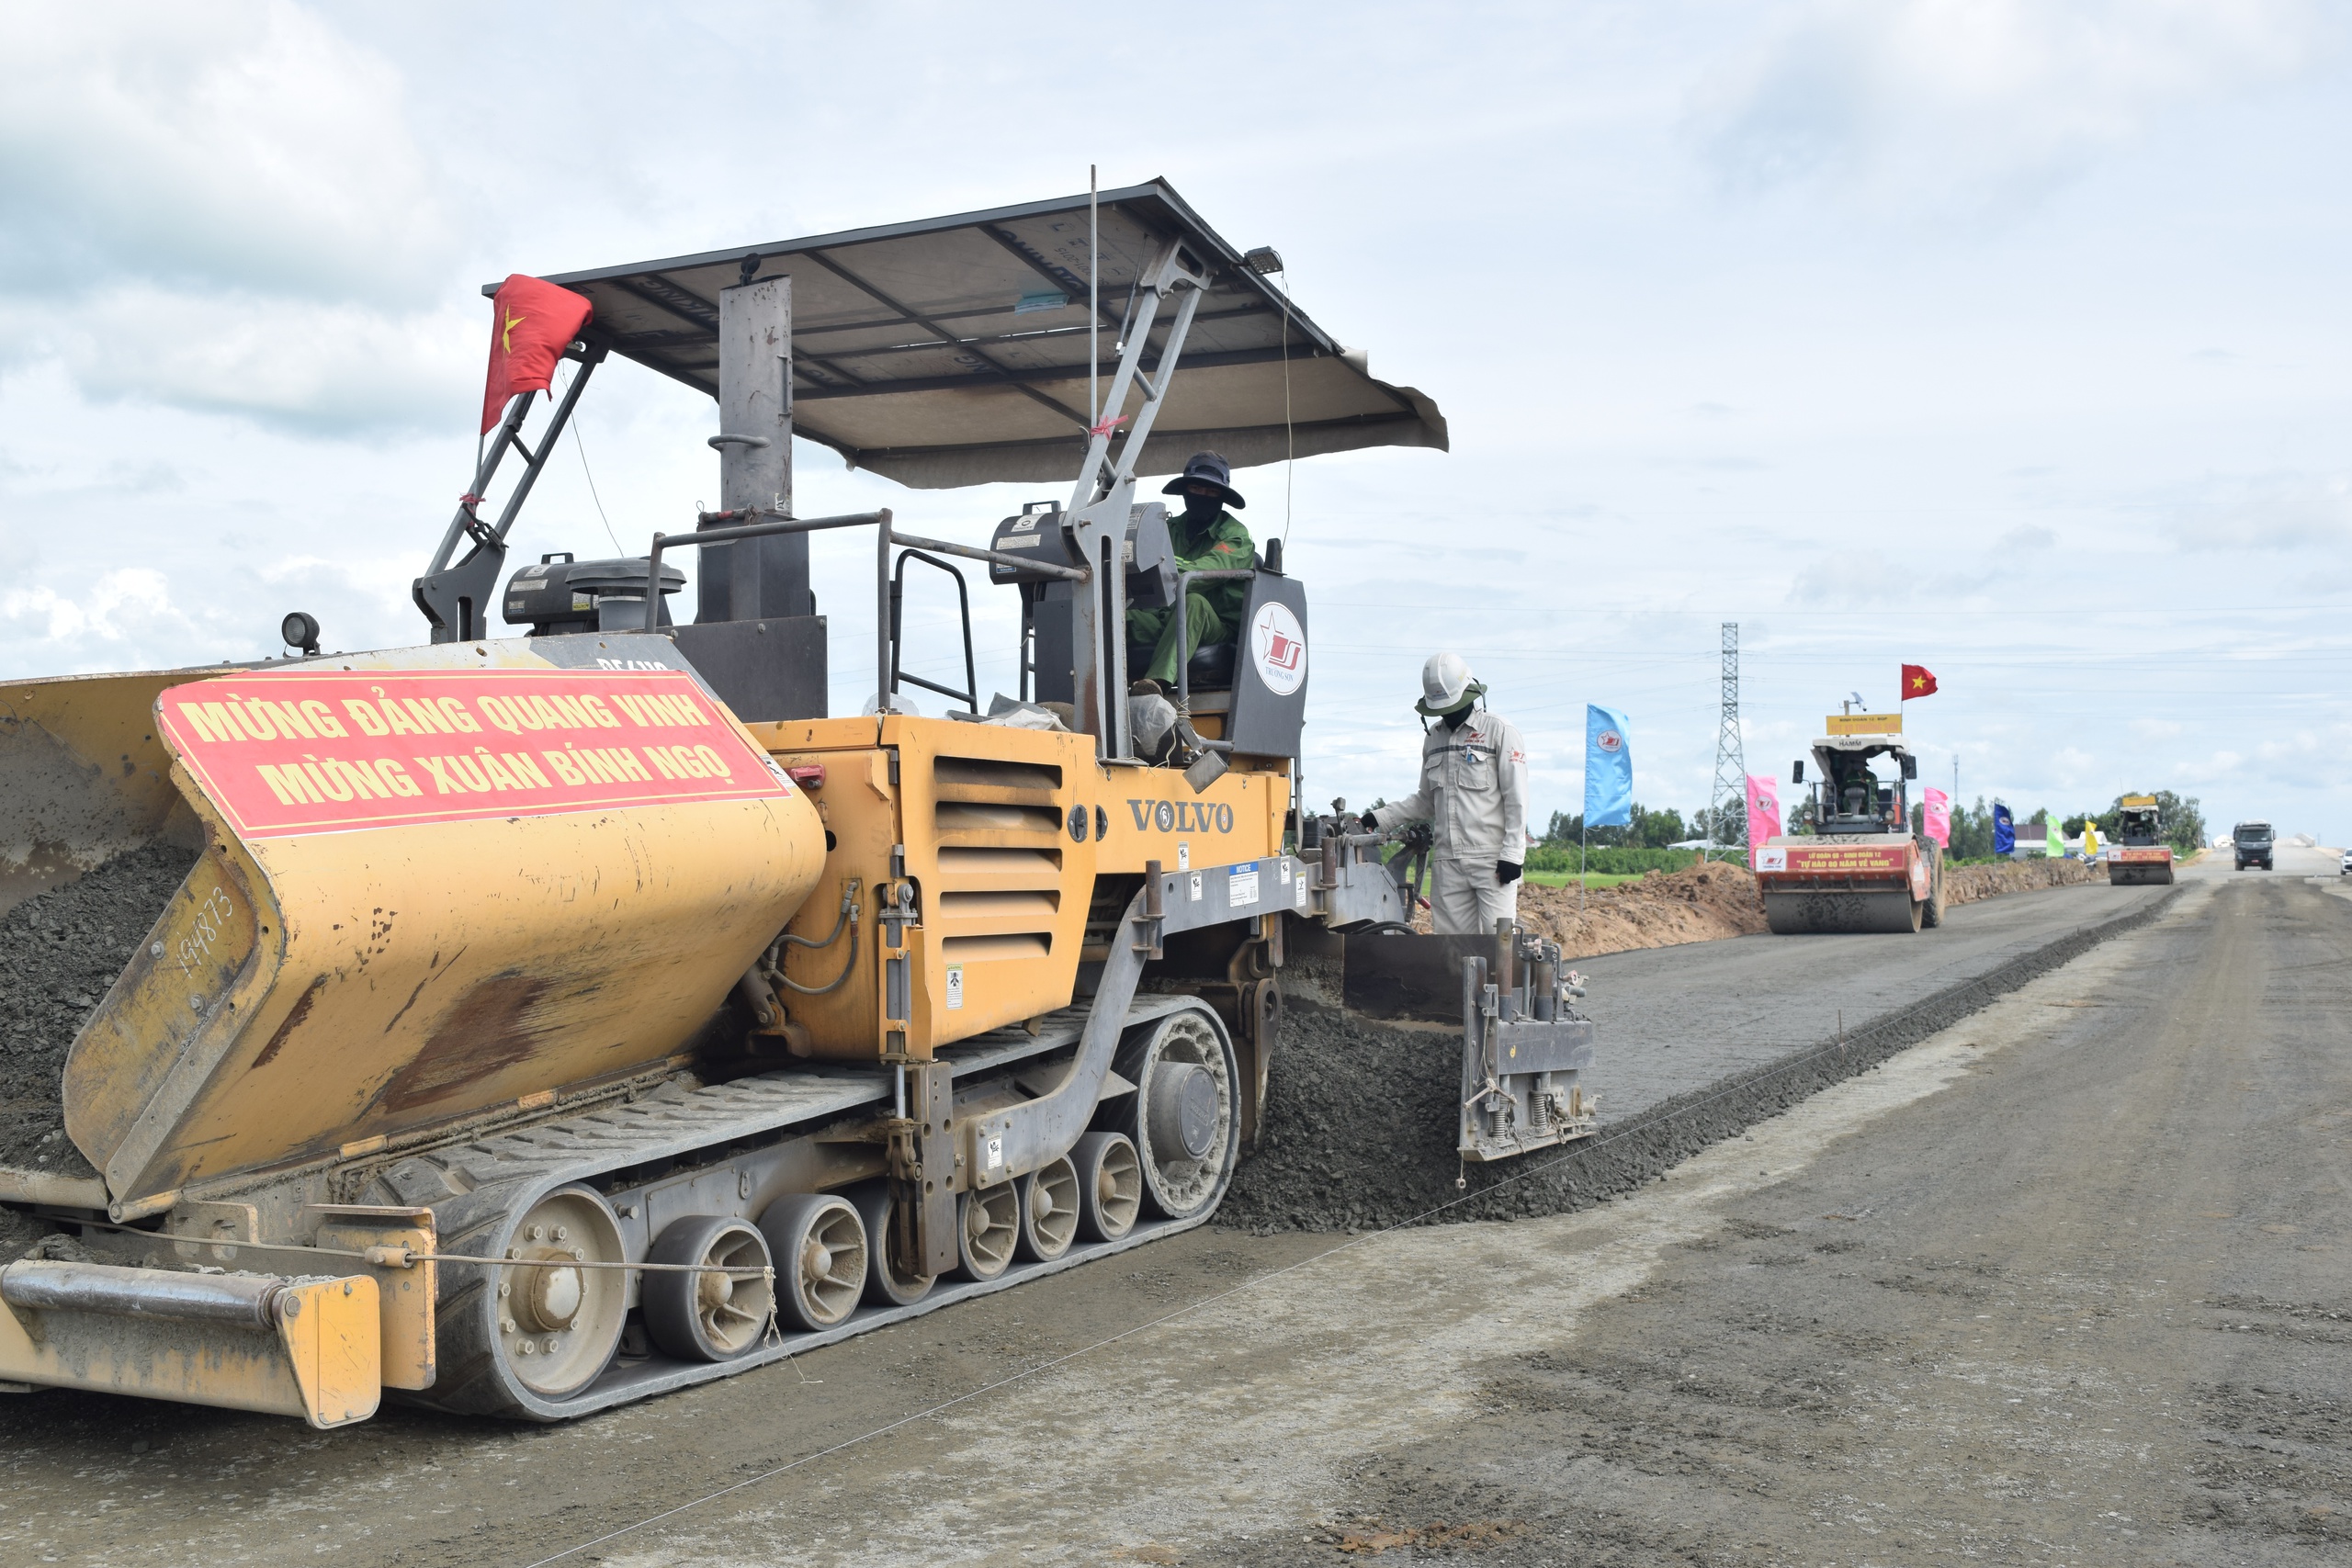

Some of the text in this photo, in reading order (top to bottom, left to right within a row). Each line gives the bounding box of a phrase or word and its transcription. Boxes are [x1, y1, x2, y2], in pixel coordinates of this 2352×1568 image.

[176, 686, 711, 742] MỪNG ĐẢNG QUANG VINH
[255, 742, 735, 806] MỪNG XUÂN BÍNH NGỌ
[1126, 799, 1234, 834] VOLVO
[1236, 863, 1251, 874] NOTICE
